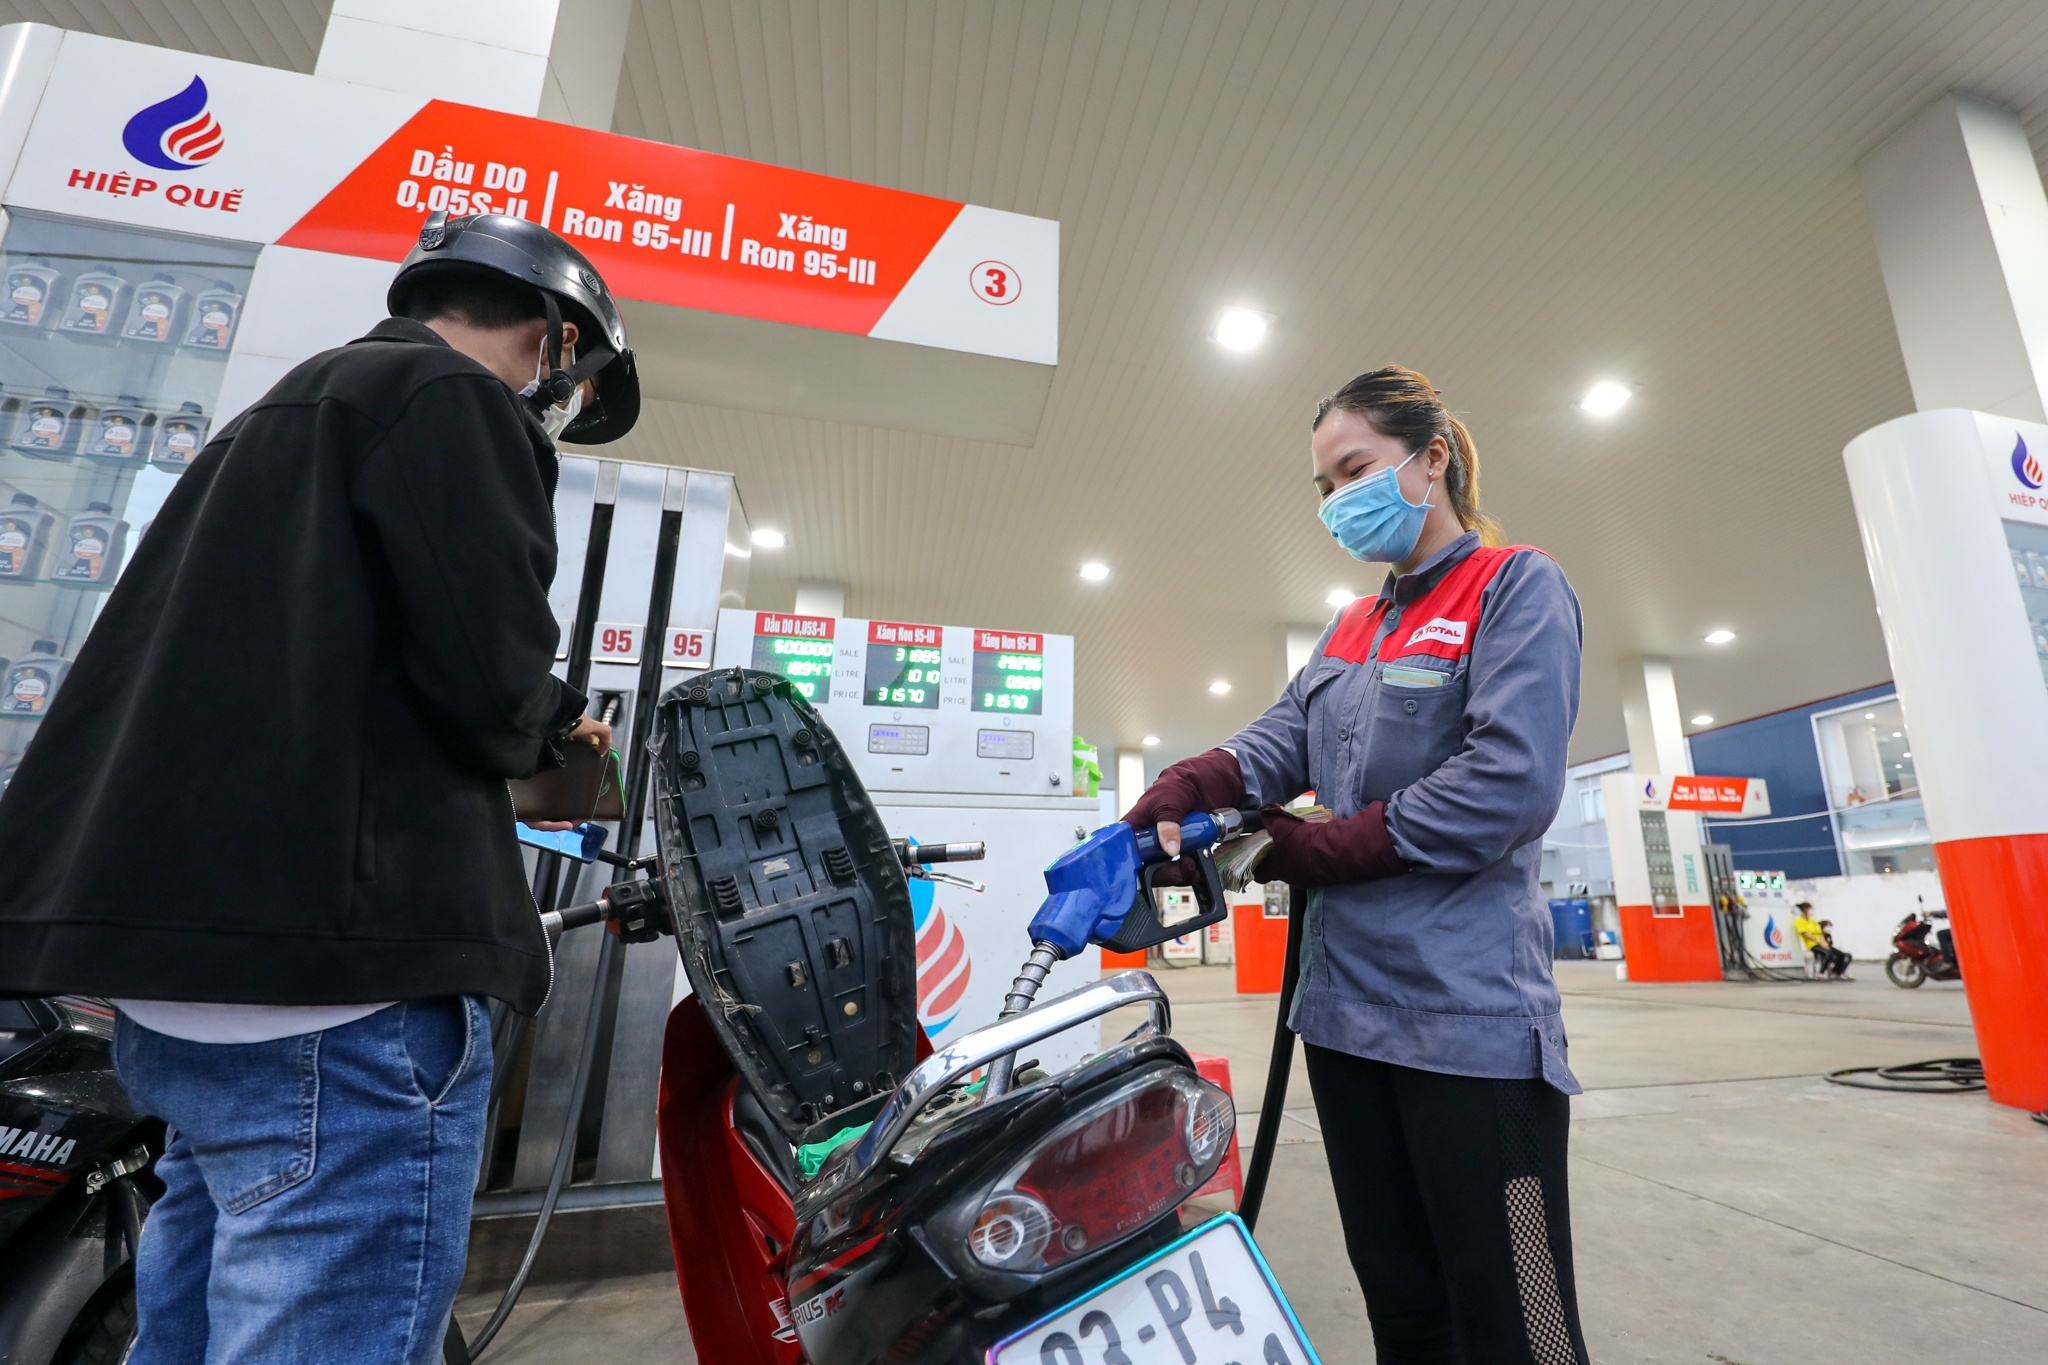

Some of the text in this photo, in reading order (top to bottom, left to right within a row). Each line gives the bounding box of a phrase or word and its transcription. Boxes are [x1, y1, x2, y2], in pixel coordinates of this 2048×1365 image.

[409, 145, 527, 193] Dầu DO
[68, 168, 244, 213] HIỆP QUẾ
[603, 181, 682, 222] Xăng
[562, 207, 713, 258] Ron 95-III
[776, 212, 847, 251] Xăng
[740, 238, 876, 286] Ron 95-III
[985, 268, 1006, 298] 3
[782, 618, 794, 634] DO
[876, 624, 936, 644] Xăng Ron 95-III
[1426, 626, 1461, 638] TOTAL
[602, 629, 632, 653] 95
[673, 633, 703, 657] 95
[774, 639, 833, 657] 500000
[981, 632, 1000, 651] Xăng
[1001, 635, 1016, 650] Ron
[840, 649, 859, 658] SALE
[948, 656, 966, 665] SALE
[835, 670, 860, 678] LITRE
[944, 677, 967, 685] LITRE
[833, 690, 858, 699] PRICE
[943, 696, 967, 705] PRICE
[825, 1286, 846, 1317] RC
